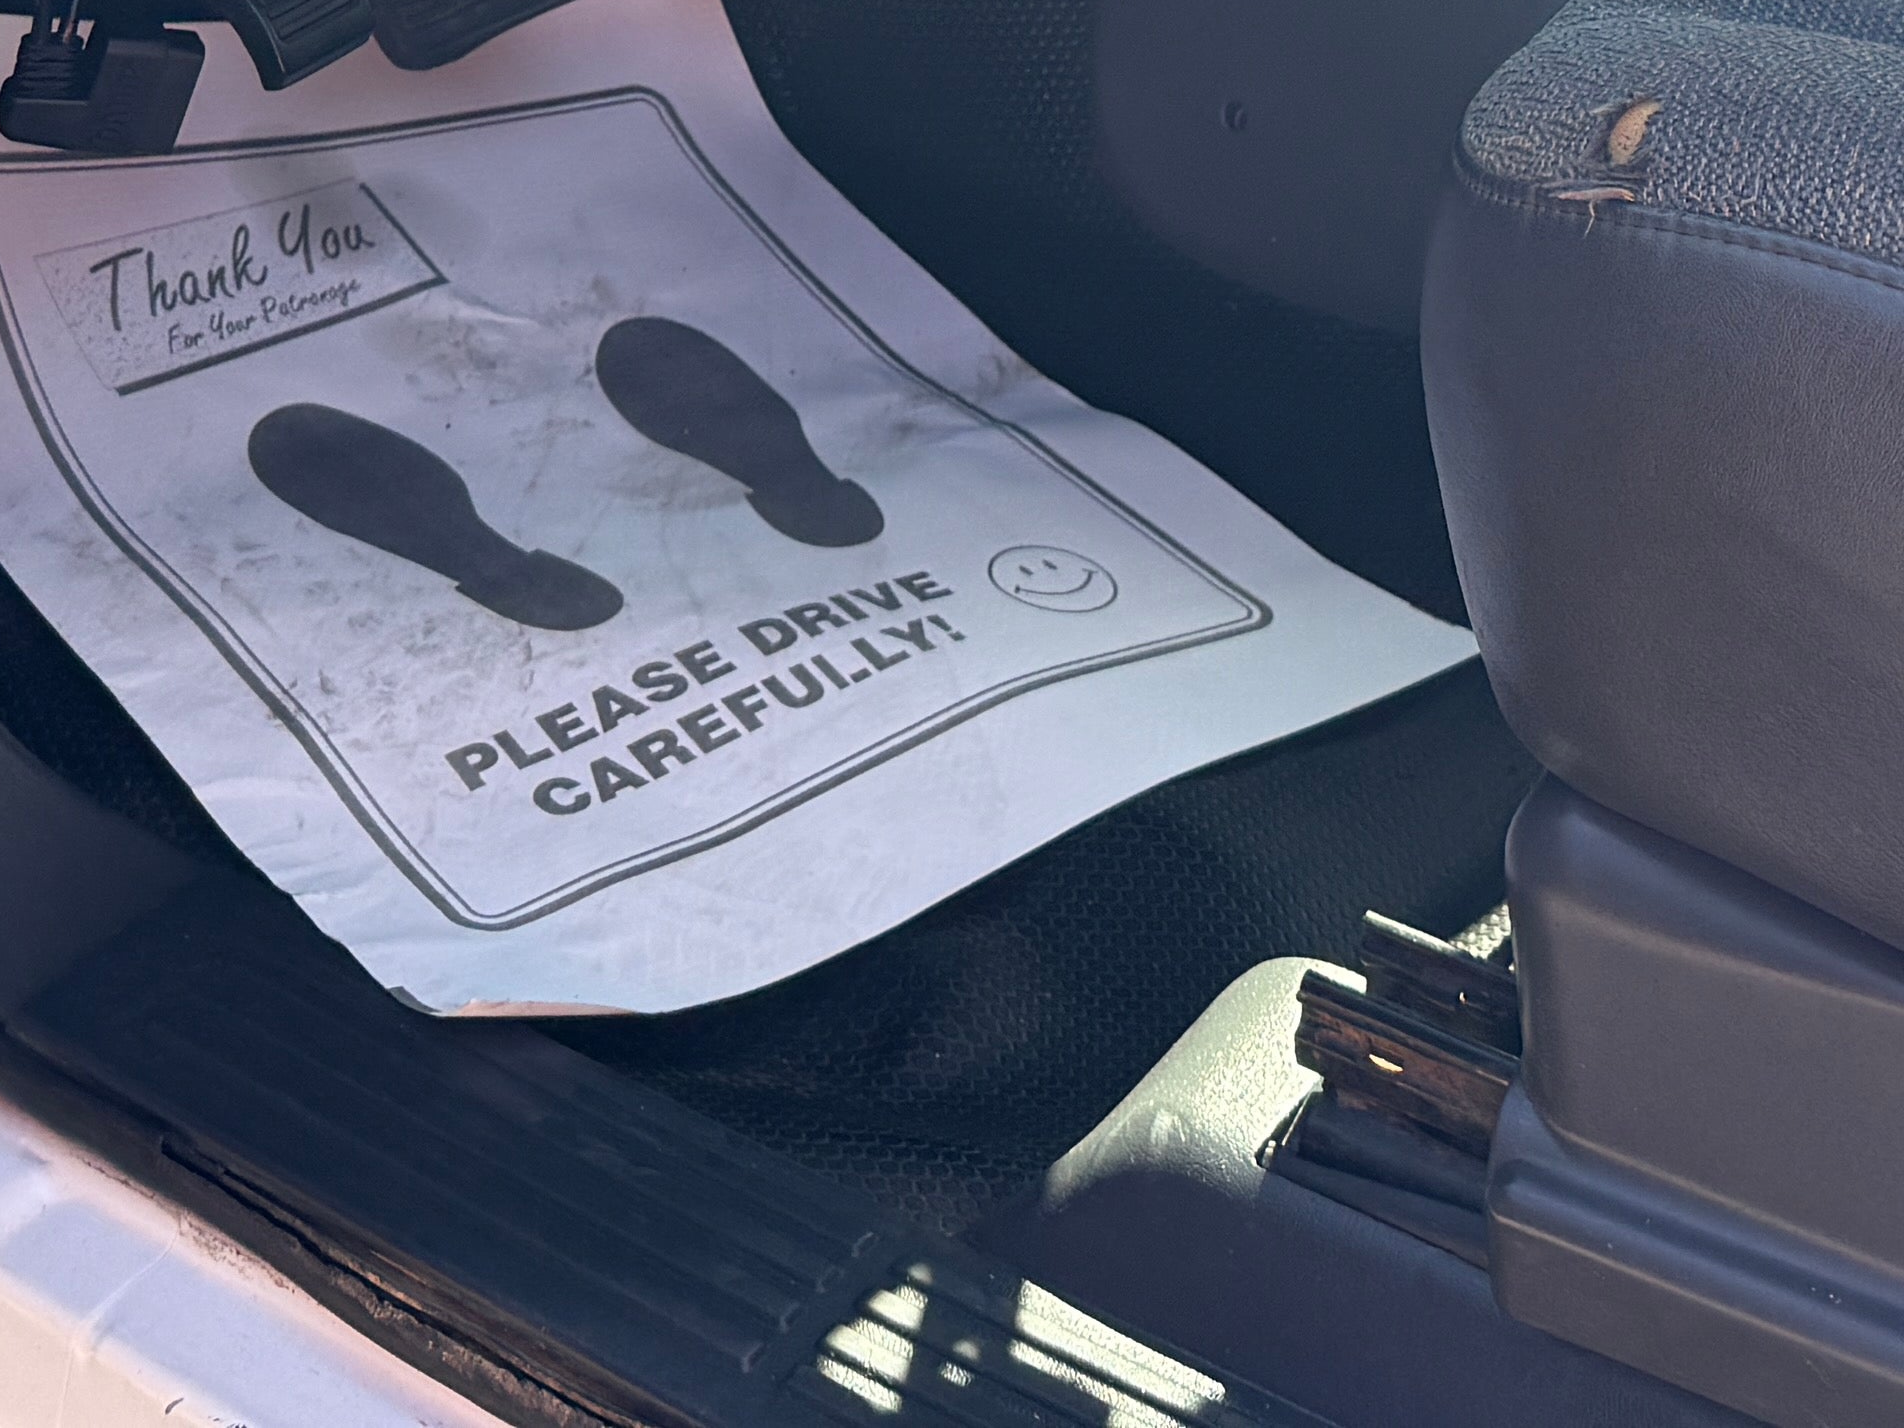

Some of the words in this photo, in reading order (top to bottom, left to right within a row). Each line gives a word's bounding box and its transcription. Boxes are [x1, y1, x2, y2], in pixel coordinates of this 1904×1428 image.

[89, 223, 268, 332] Thank
[277, 203, 376, 275] You
[167, 322, 204, 355] For
[209, 309, 257, 341] Your
[444, 639, 737, 792] PLEASE
[737, 570, 954, 656] DRIVE
[532, 613, 967, 816] CAREFULLY!
